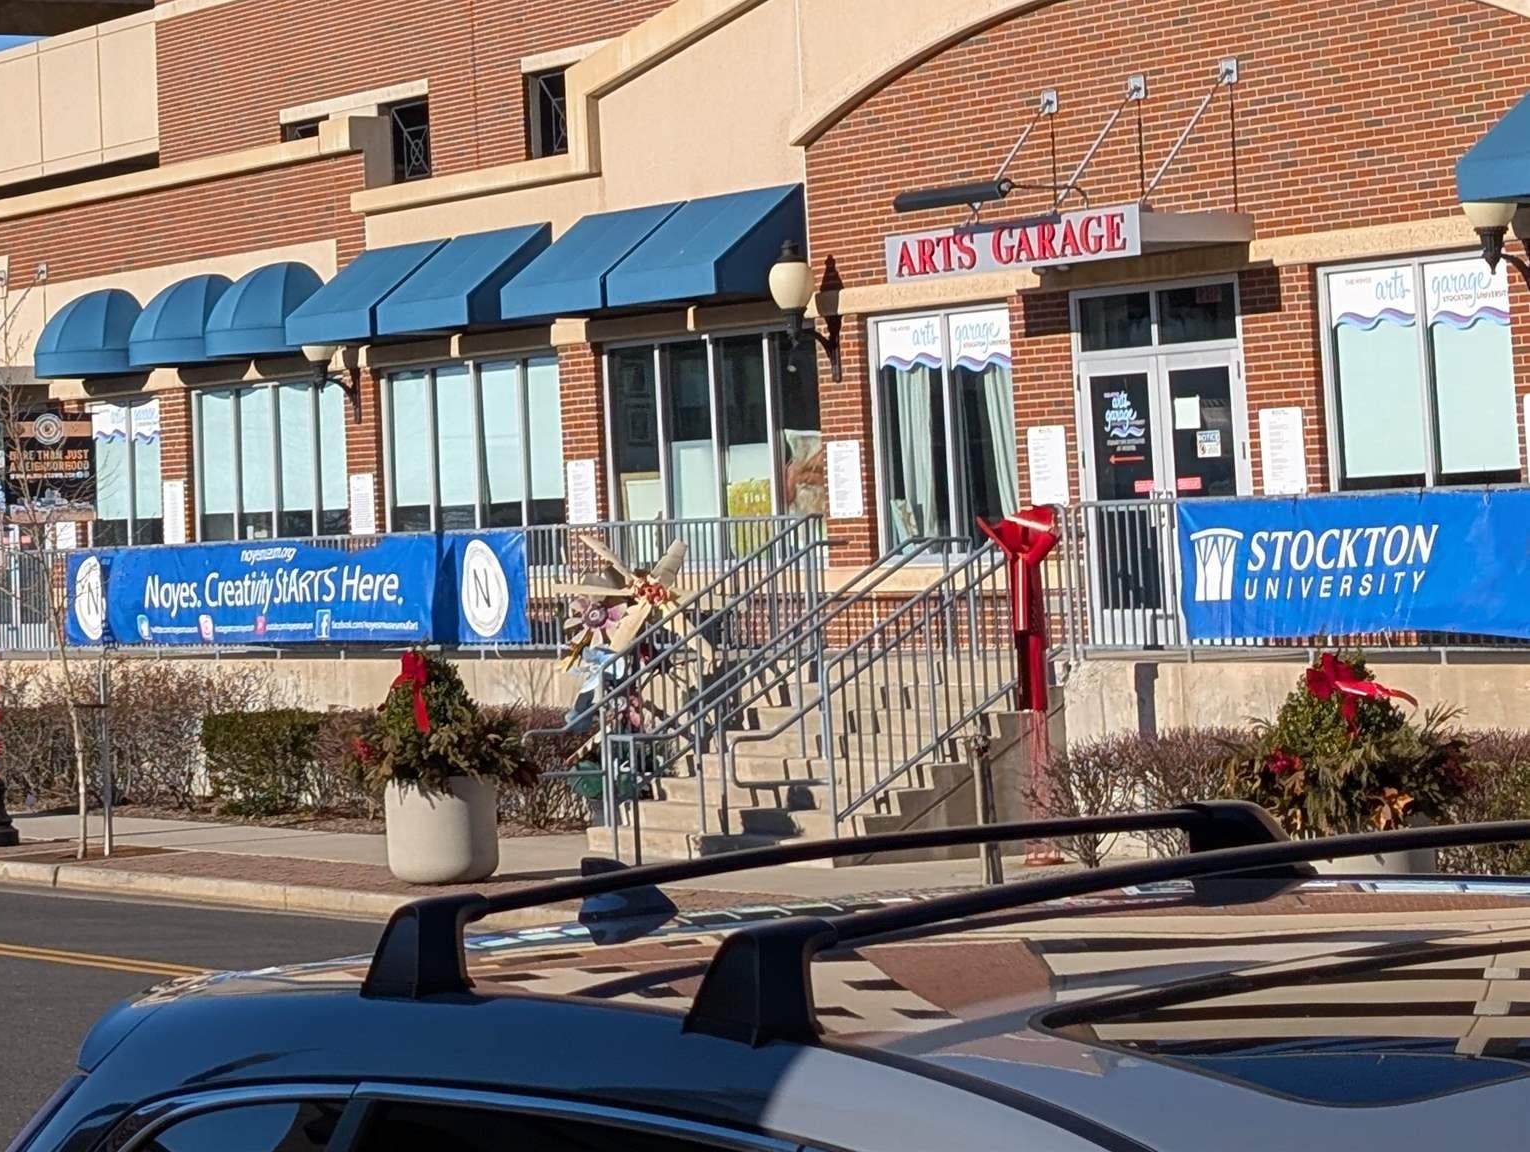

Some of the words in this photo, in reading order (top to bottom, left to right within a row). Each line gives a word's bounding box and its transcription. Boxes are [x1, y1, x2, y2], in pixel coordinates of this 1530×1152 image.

[896, 233, 977, 278] ARTS
[991, 212, 1126, 266] GARAGE
[1375, 270, 1412, 302] arts
[1430, 270, 1492, 312] garage
[1476, 289, 1507, 300] UNIVERSIT
[912, 319, 940, 346] arts
[954, 321, 1000, 356] garage
[37, 449, 62, 461] THAN
[64, 448, 90, 461] JUST
[1247, 524, 1439, 572] STOCKTON
[144, 574, 202, 618] Noyes.
[204, 570, 274, 615] Creativity
[273, 565, 339, 605] StARTS
[341, 564, 405, 606] Here.
[1244, 570, 1426, 601] UNIVERSITY
